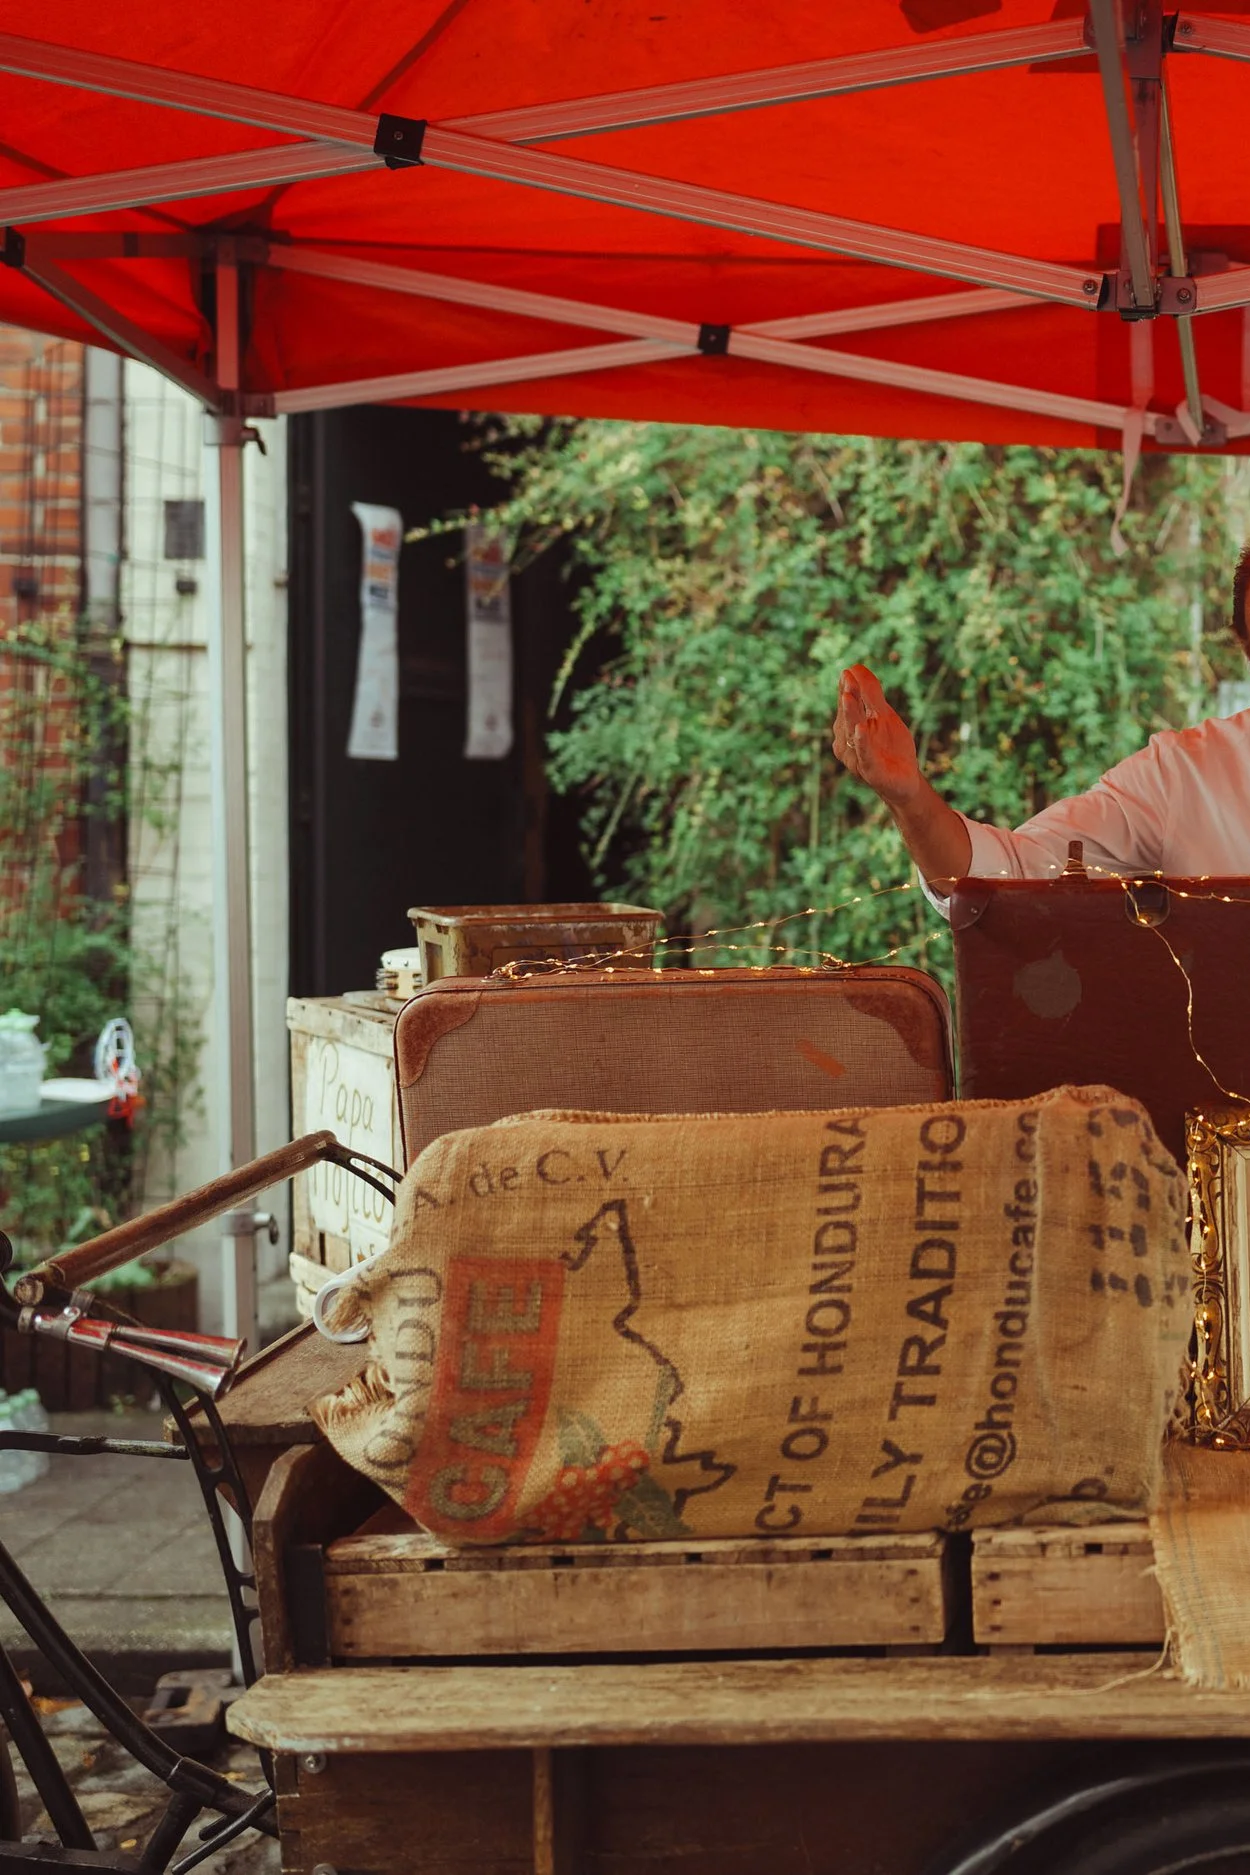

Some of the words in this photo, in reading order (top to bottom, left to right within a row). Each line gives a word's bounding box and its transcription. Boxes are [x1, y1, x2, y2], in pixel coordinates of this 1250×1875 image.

[320, 1040, 375, 1152] Papa
[469, 1161, 520, 1198] de
[797, 1113, 868, 1377] HONDURA
[850, 1439, 924, 1534] ILY
[887, 1113, 967, 1421] TRADITIO
[427, 1279, 543, 1522] CAFE
[781, 1396, 834, 1462] OF
